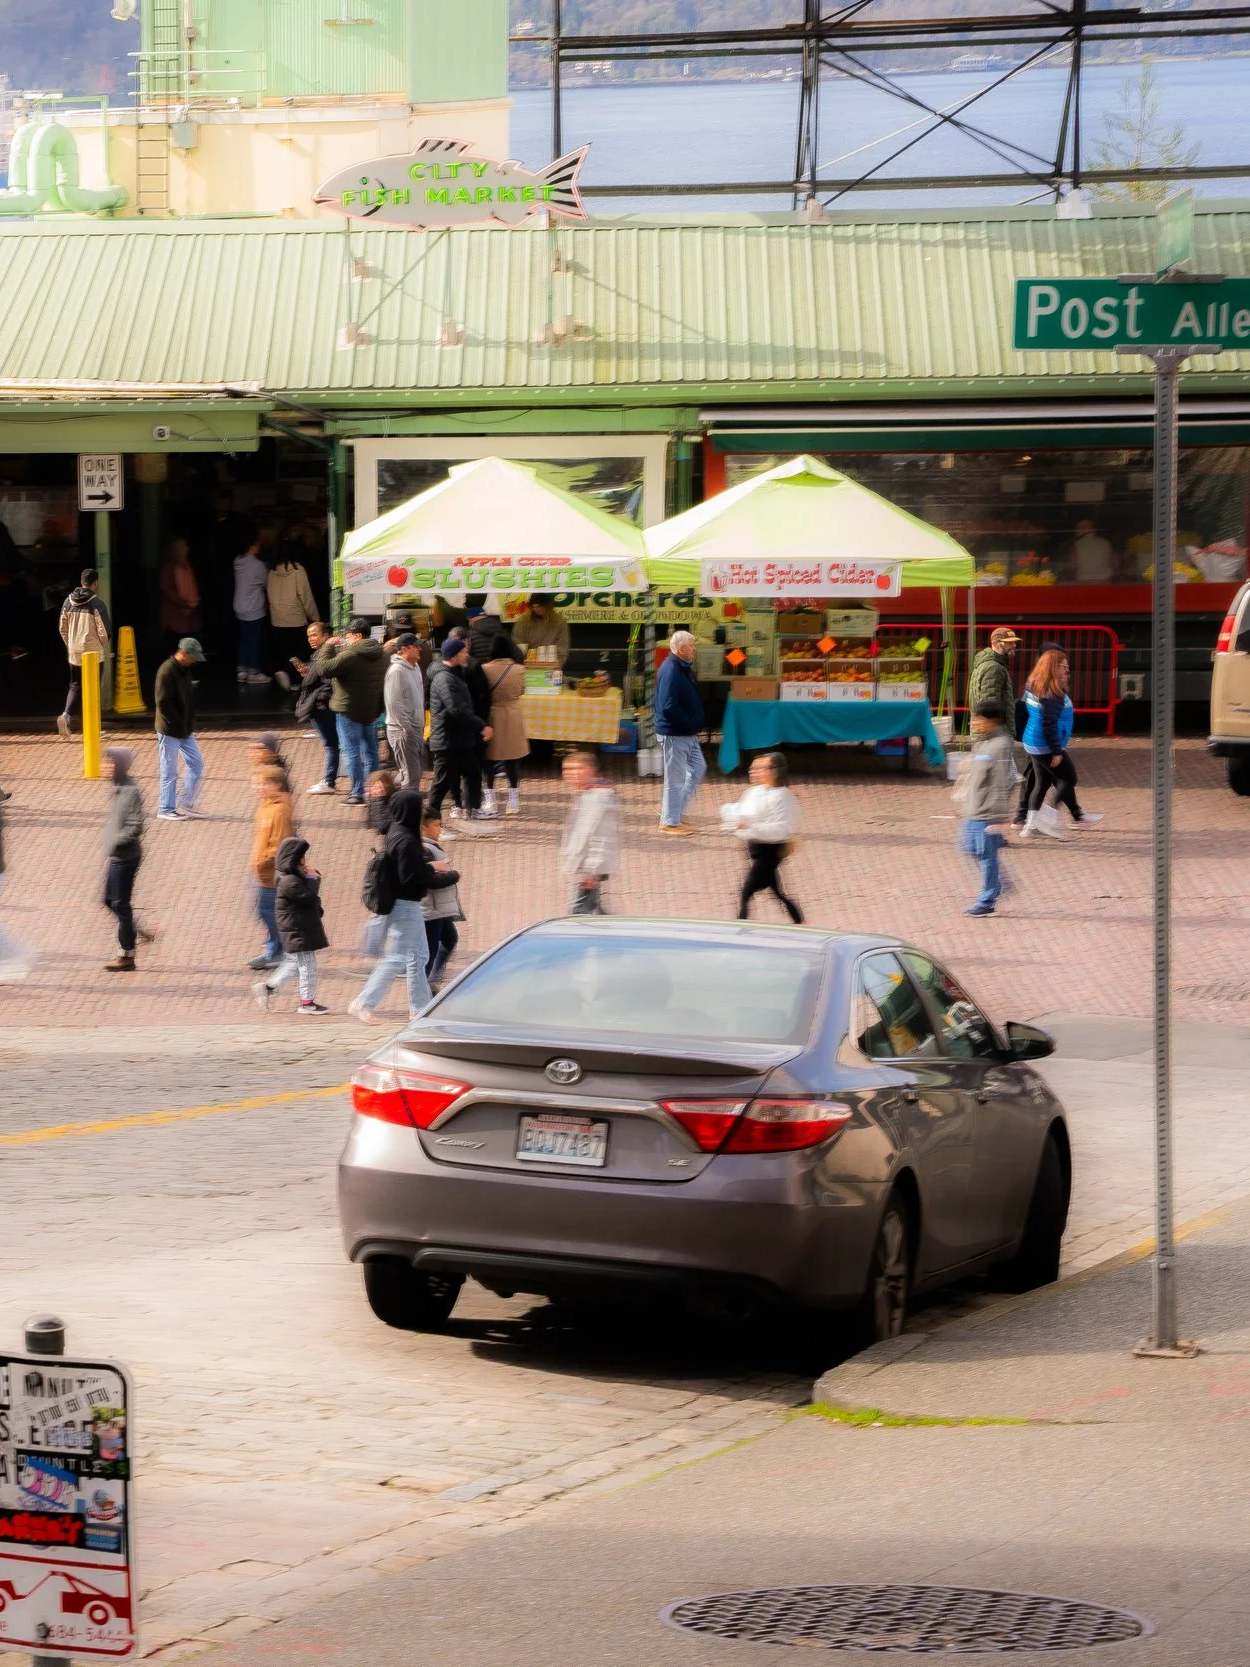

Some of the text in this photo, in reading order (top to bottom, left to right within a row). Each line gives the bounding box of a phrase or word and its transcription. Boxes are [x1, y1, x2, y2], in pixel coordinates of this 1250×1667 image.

[409, 161, 490, 181] CITY
[341, 184, 557, 208] FISH MARKET
[1027, 285, 1145, 339] Post
[84, 458, 118, 472] ONE
[84, 474, 118, 488] WAY
[453, 557, 574, 567] APPLE CIDER
[410, 566, 616, 589] SLUSHIES
[728, 563, 876, 591] Hot Spiced Cider
